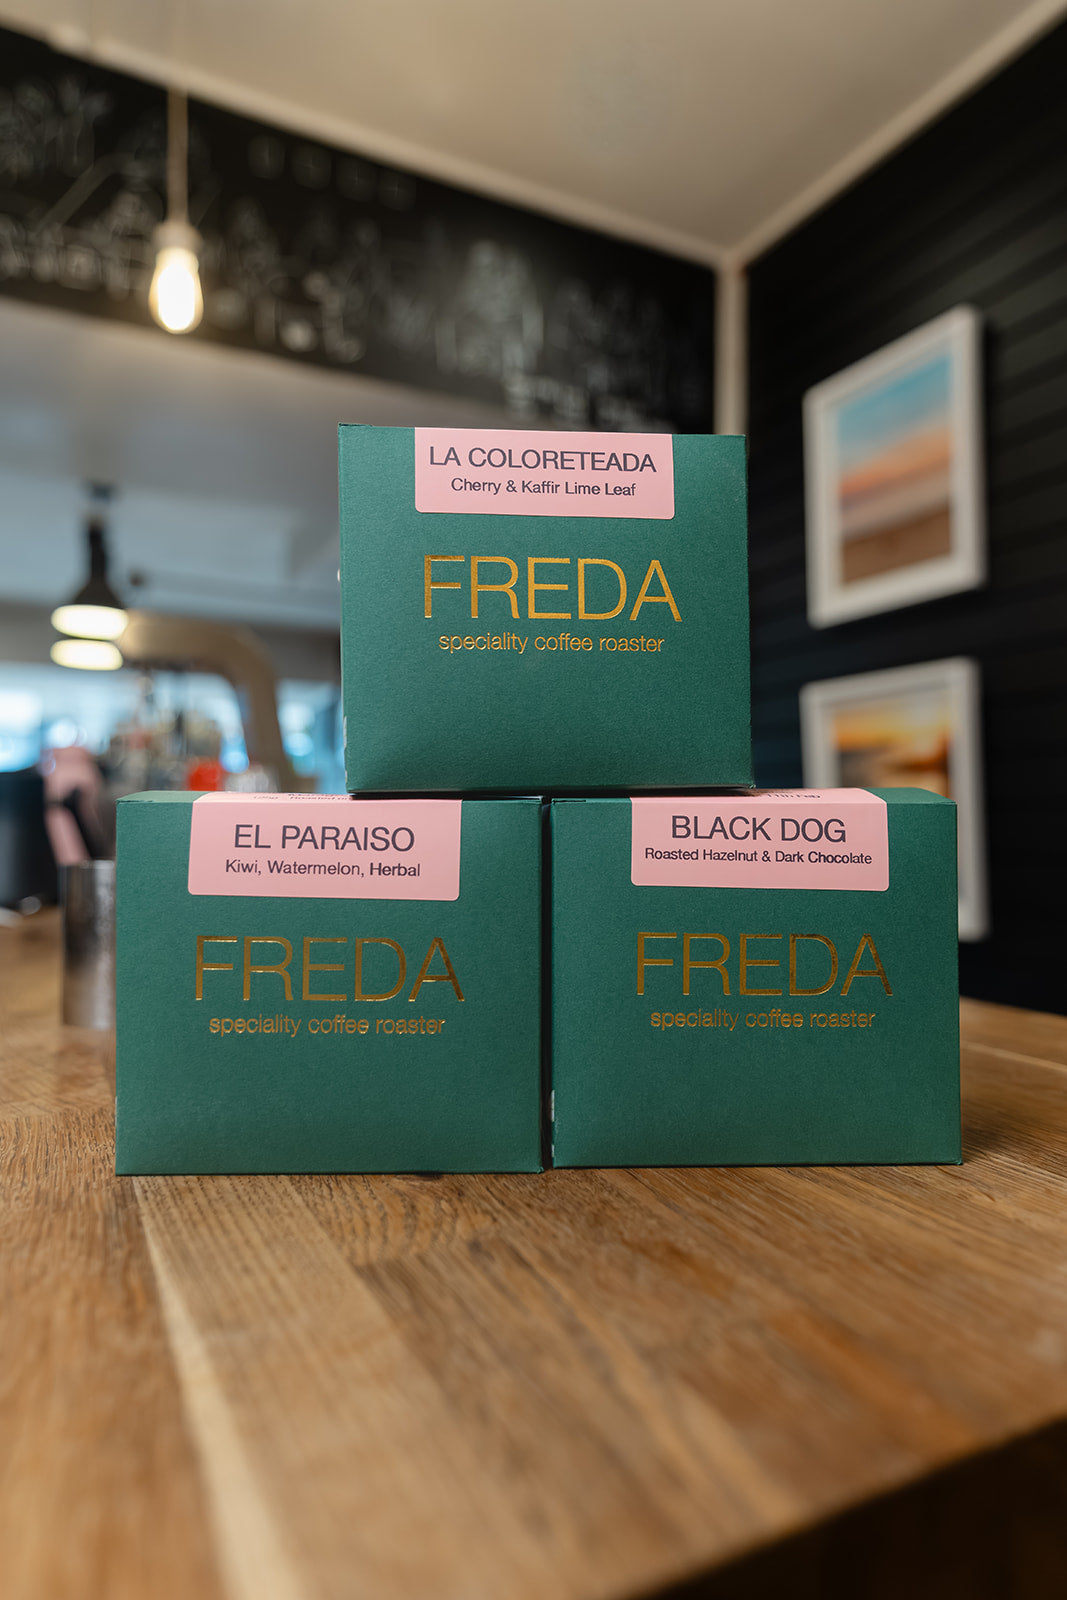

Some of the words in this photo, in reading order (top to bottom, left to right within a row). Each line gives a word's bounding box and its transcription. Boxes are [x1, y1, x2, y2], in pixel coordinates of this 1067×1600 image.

[429, 446, 461, 467] LA
[468, 447, 658, 473] COLORETEADA
[451, 477, 501, 496] Cherry
[506, 479, 517, 493] &
[521, 480, 560, 494] Kaffir
[565, 481, 600, 496] Lime
[605, 482, 636, 497] Leaf
[423, 554, 683, 623] FREDA
[438, 631, 529, 655] speciality
[534, 632, 593, 652] coffee
[599, 634, 665, 652] roaster
[234, 823, 271, 849] EL
[281, 824, 415, 853] PARAISO
[671, 815, 772, 842] BLACK
[780, 817, 847, 844] DOG
[225, 858, 262, 876] Kiwi,
[267, 859, 365, 878] Watermelon,
[369, 861, 421, 877] Herbal
[644, 847, 699, 861] Roasted
[702, 848, 759, 863] Hazelnut
[761, 850, 772, 863] &
[774, 850, 805, 864] Dark
[807, 850, 873, 865] Chocolate
[195, 934, 466, 1003] FREDA
[636, 931, 894, 997] FREDA
[208, 1013, 302, 1038] speciality
[307, 1013, 370, 1035] coffee
[375, 1015, 446, 1035] roaster
[650, 1008, 740, 1032] speciality
[745, 1008, 804, 1028] coffee
[809, 1009, 876, 1028] roaster
